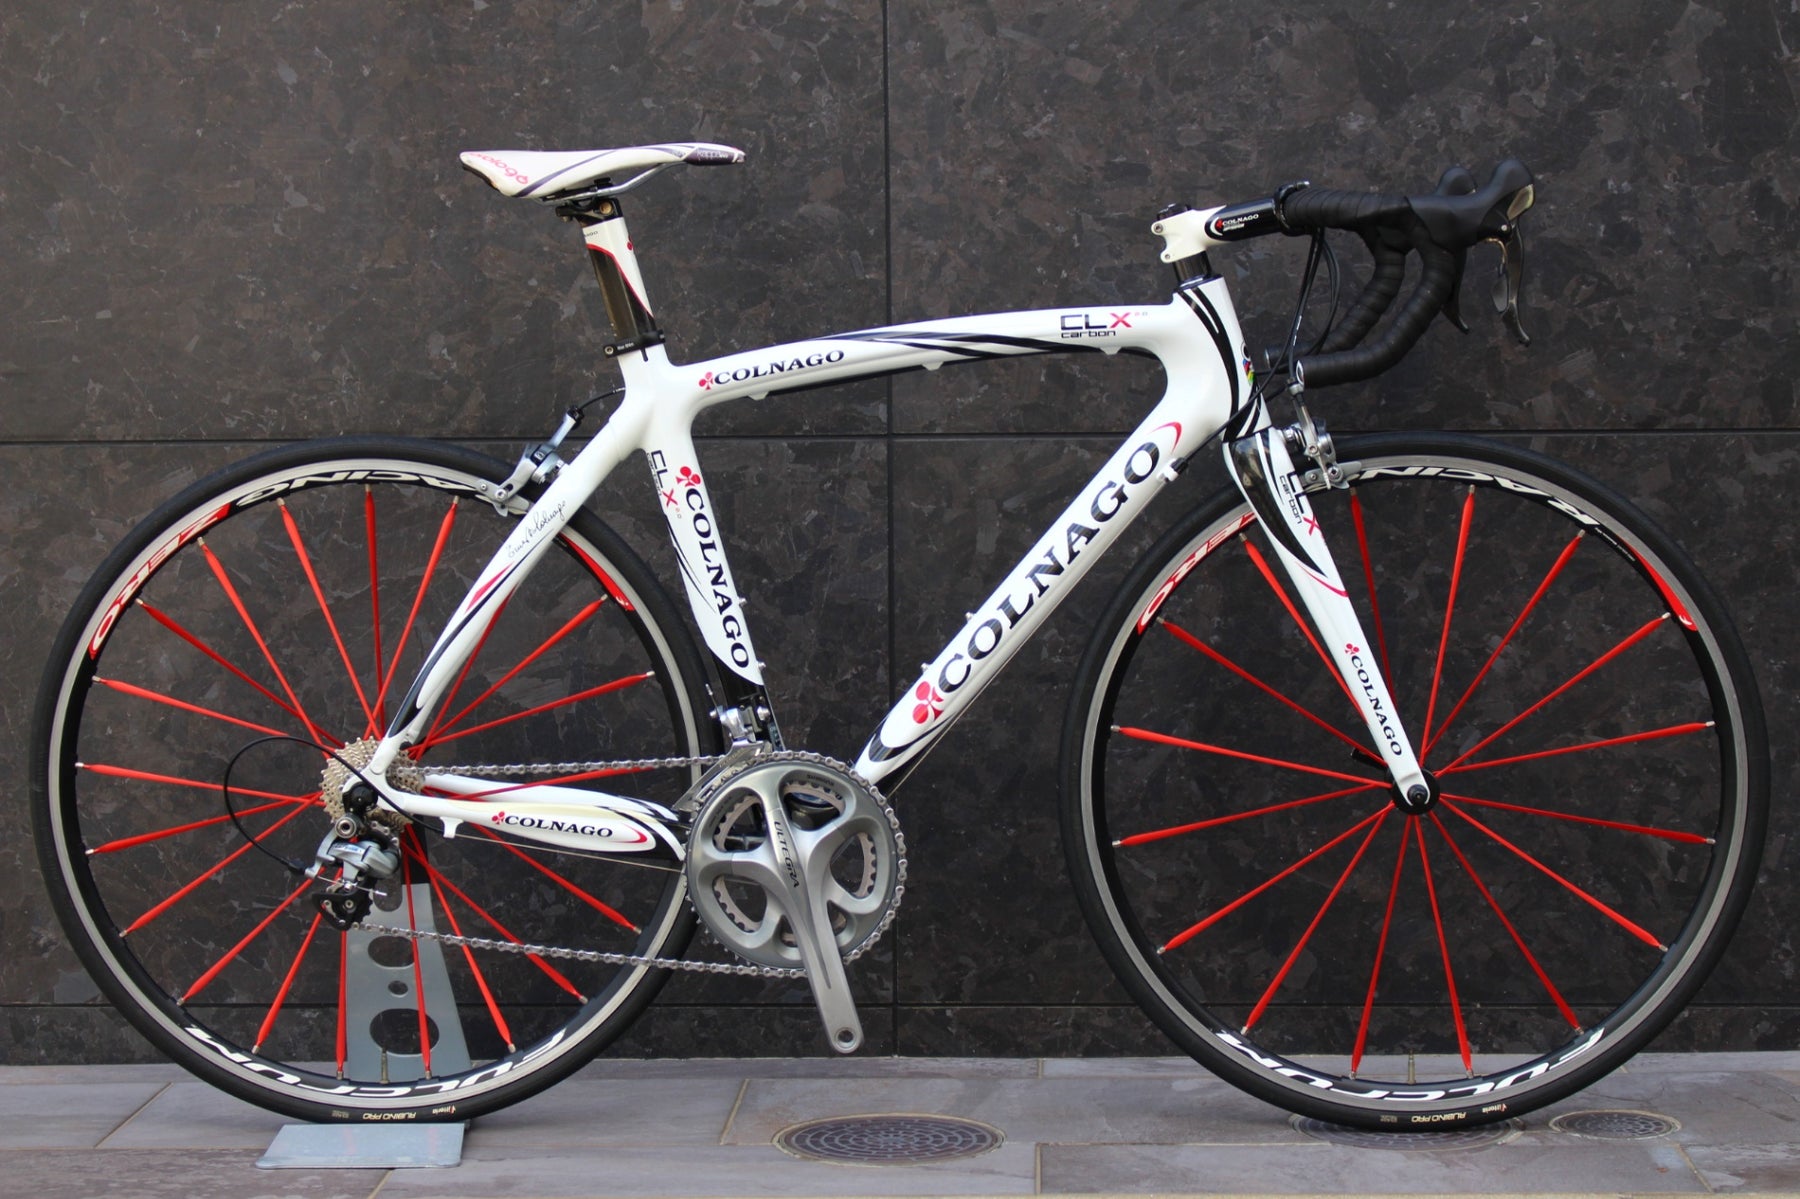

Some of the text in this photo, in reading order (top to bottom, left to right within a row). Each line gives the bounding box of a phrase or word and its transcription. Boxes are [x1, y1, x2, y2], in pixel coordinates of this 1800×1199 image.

[1222, 213, 1259, 226] COLNAGO
[1060, 312, 1132, 331] CLX
[1061, 330, 1116, 338] carbon
[714, 350, 845, 385] COLNAGO
[651, 449, 678, 508] CLX
[1279, 474, 1303, 525] carbon
[92, 505, 226, 652] ZERO
[685, 487, 750, 669] COLNAGO
[938, 441, 1160, 694] COLNAGO
[1351, 655, 1402, 756] COLNAGO
[504, 815, 613, 838] COLNAGO
[774, 821, 800, 888] ULTEGRA
[184, 1024, 567, 1098] FULCRUM
[1215, 1027, 1606, 1102] FULCRUM
[362, 1112, 383, 1120] PRO
[1411, 1115, 1432, 1123] PRO
